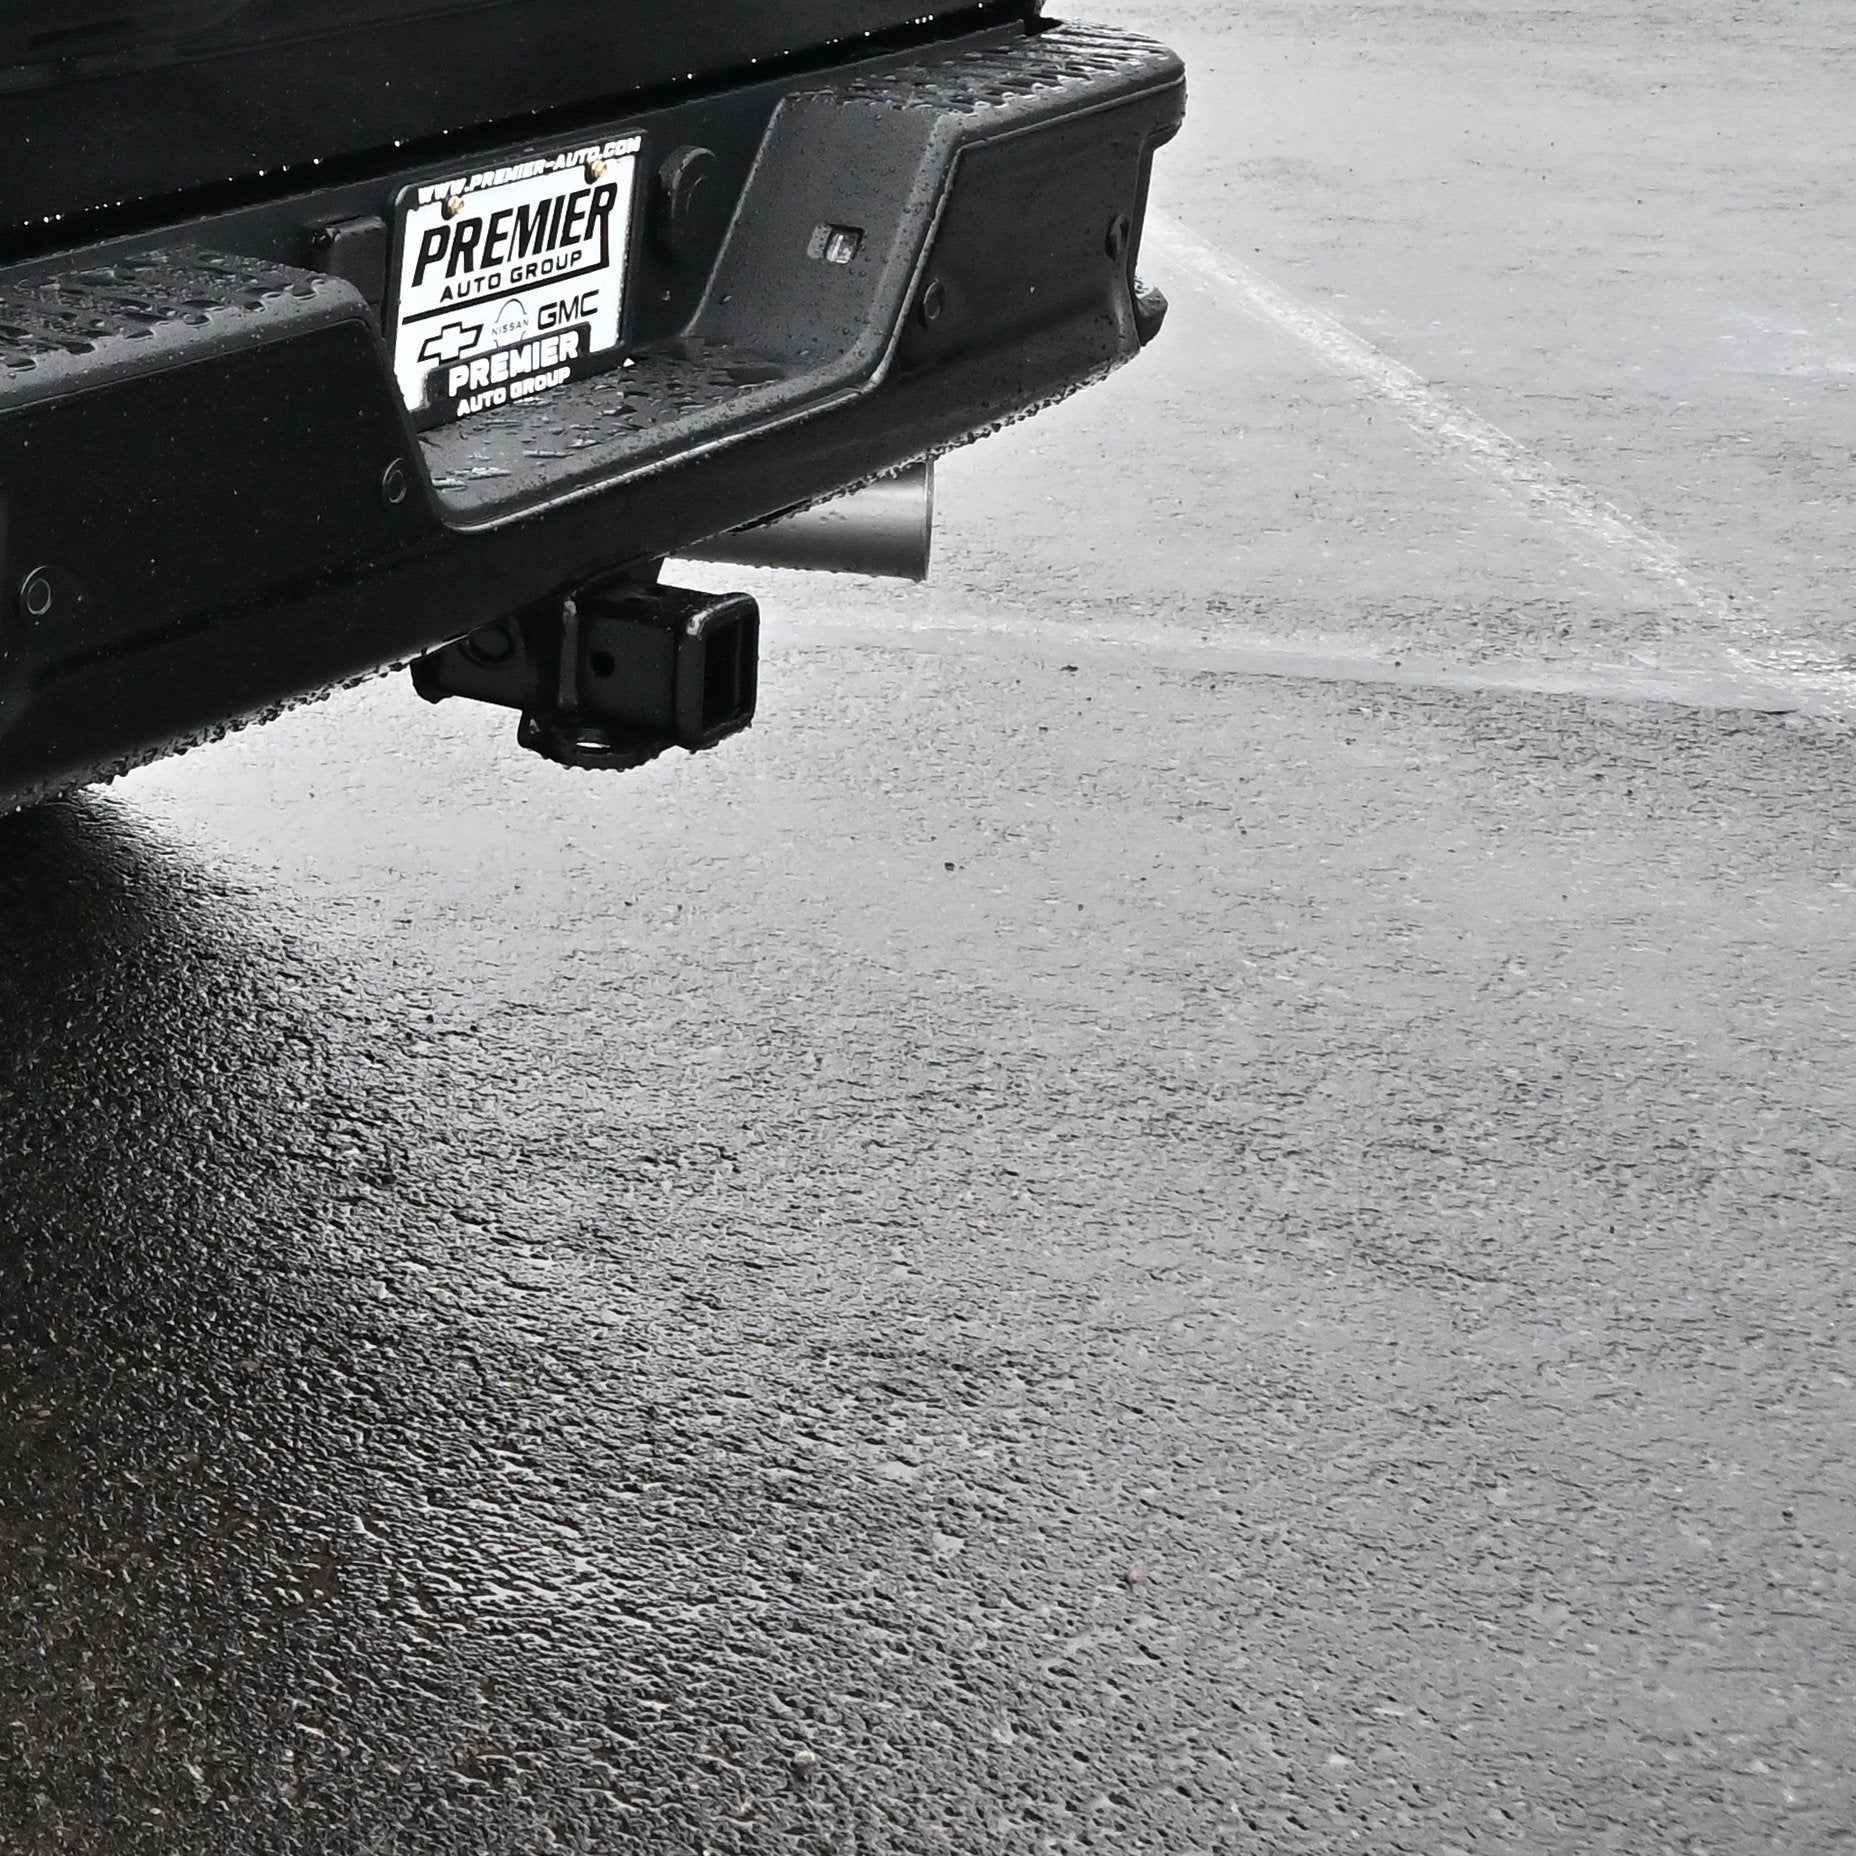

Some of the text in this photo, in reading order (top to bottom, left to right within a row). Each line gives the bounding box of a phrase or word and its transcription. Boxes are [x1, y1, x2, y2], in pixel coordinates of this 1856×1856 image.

[417, 136, 642, 204] WWW.PREMIER-AUTO.COM
[411, 182, 618, 288] PREMIER
[440, 249, 582, 303] AUTO GROUP
[491, 318, 530, 336] NISSAN
[537, 289, 600, 331] GMC
[448, 330, 580, 397] PREMIER
[457, 366, 571, 417] AUTO GROUP
